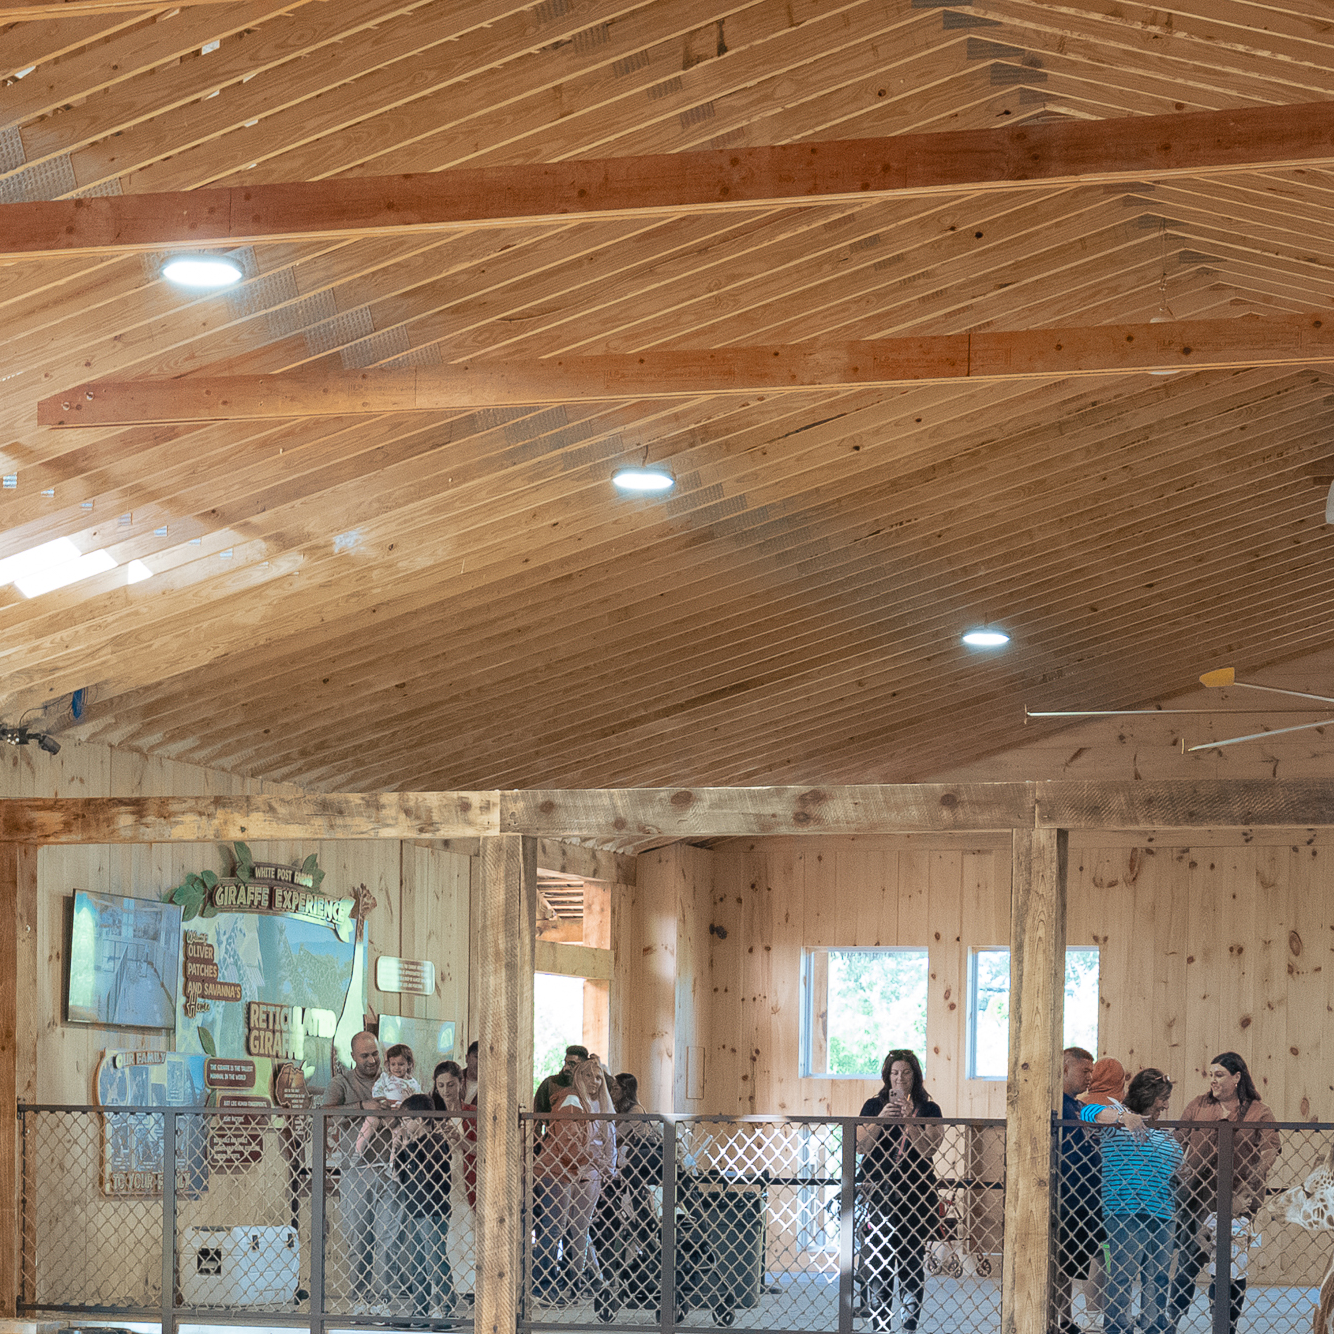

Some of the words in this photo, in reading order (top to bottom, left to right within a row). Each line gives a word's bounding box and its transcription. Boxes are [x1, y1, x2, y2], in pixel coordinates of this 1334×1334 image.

[255, 866, 275, 878] WHITE
[277, 869, 292, 882] POST
[215, 885, 269, 906] GIRAFFE
[275, 889, 345, 922] EXPERIENCE
[188, 944, 213, 959] OLIVER
[188, 963, 218, 977] PATCHES
[187, 981, 202, 994] AND
[204, 983, 241, 998] SAVANNA'S
[137, 1052, 166, 1064] FAMILY
[128, 1173, 153, 1189] YOUR
[158, 1172, 191, 1190] FLY
